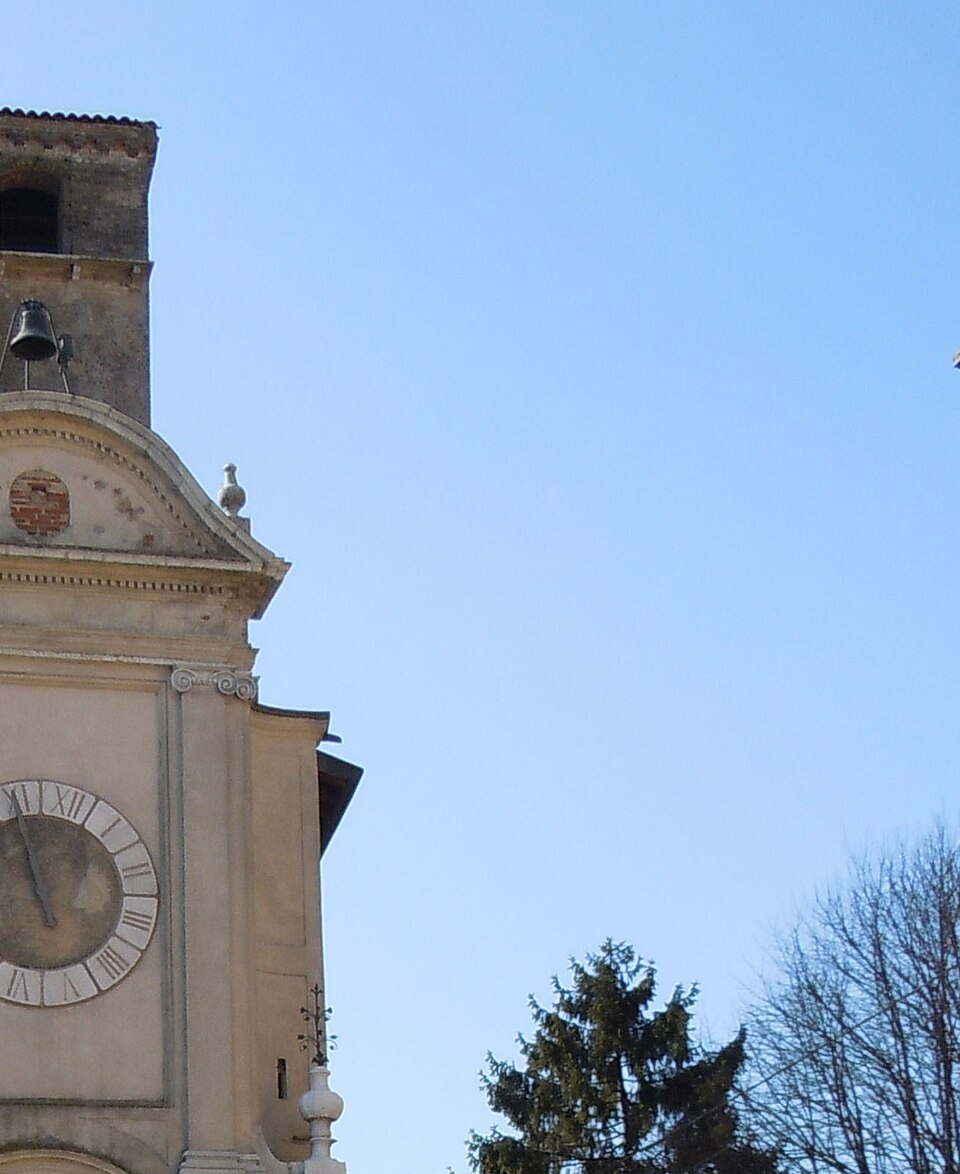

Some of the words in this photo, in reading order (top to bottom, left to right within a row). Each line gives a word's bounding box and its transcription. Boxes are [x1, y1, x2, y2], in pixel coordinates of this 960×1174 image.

[55, 786, 86, 820] XII
[101, 817, 123, 838] I
[122, 862, 153, 880] II
[122, 909, 153, 932] III
[97, 946, 129, 981] IIII
[6, 969, 29, 1001] VI
[63, 972, 80, 1000] V
